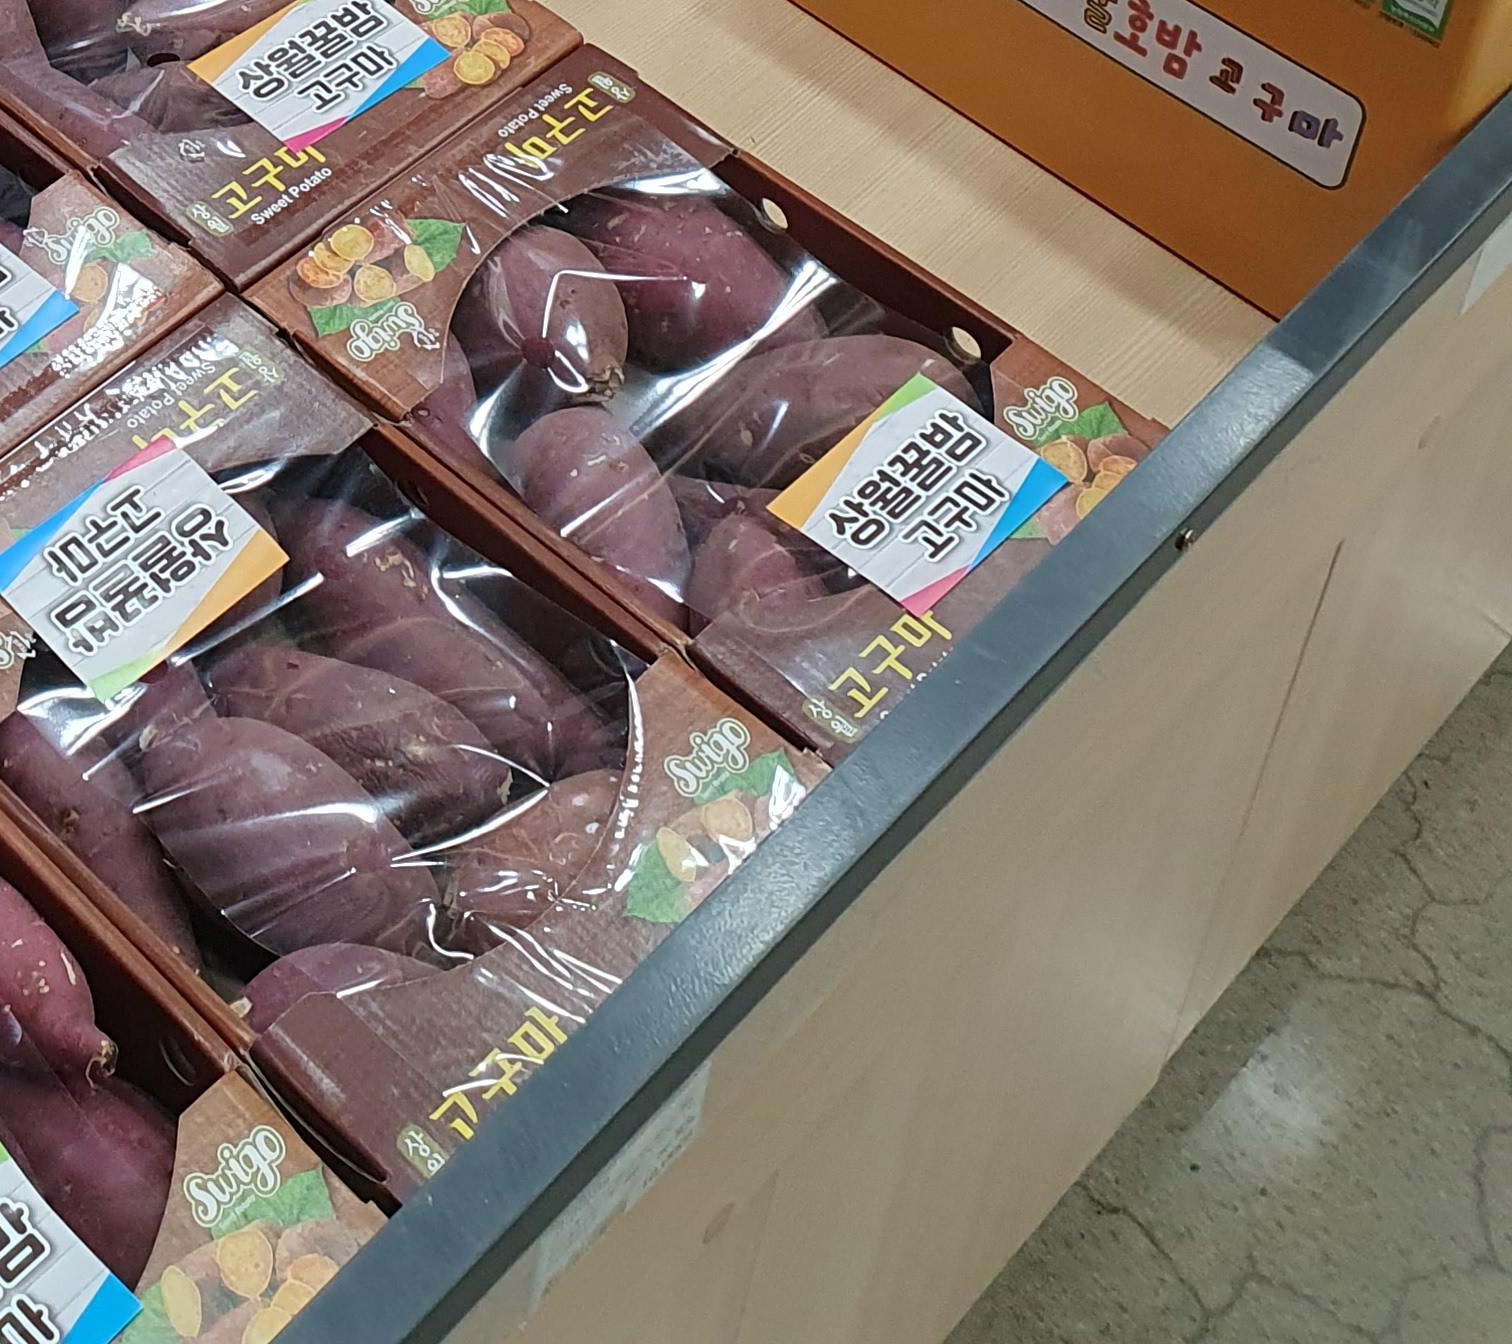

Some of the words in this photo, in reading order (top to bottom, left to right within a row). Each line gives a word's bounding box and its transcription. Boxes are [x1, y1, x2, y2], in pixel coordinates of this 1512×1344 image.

[294, 43, 399, 114] 고구마
[1208, 57, 1344, 148] 고구마
[504, 87, 614, 168] 고구마
[211, 144, 328, 220] 고구마
[250, 192, 292, 226] Sweet
[289, 166, 333, 202] Potato
[347, 301, 425, 362] Swigo
[1003, 375, 1079, 441] Swigo
[826, 409, 988, 550] 상월꿀밤
[899, 469, 1012, 563] 고구마
[44, 486, 165, 585] 고구마
[50, 505, 233, 656] 상월꿀밤
[827, 609, 953, 718] 고구마
[663, 717, 752, 798] Swigo
[430, 1006, 569, 1141] 고구마
[183, 1125, 286, 1227] Swigo
